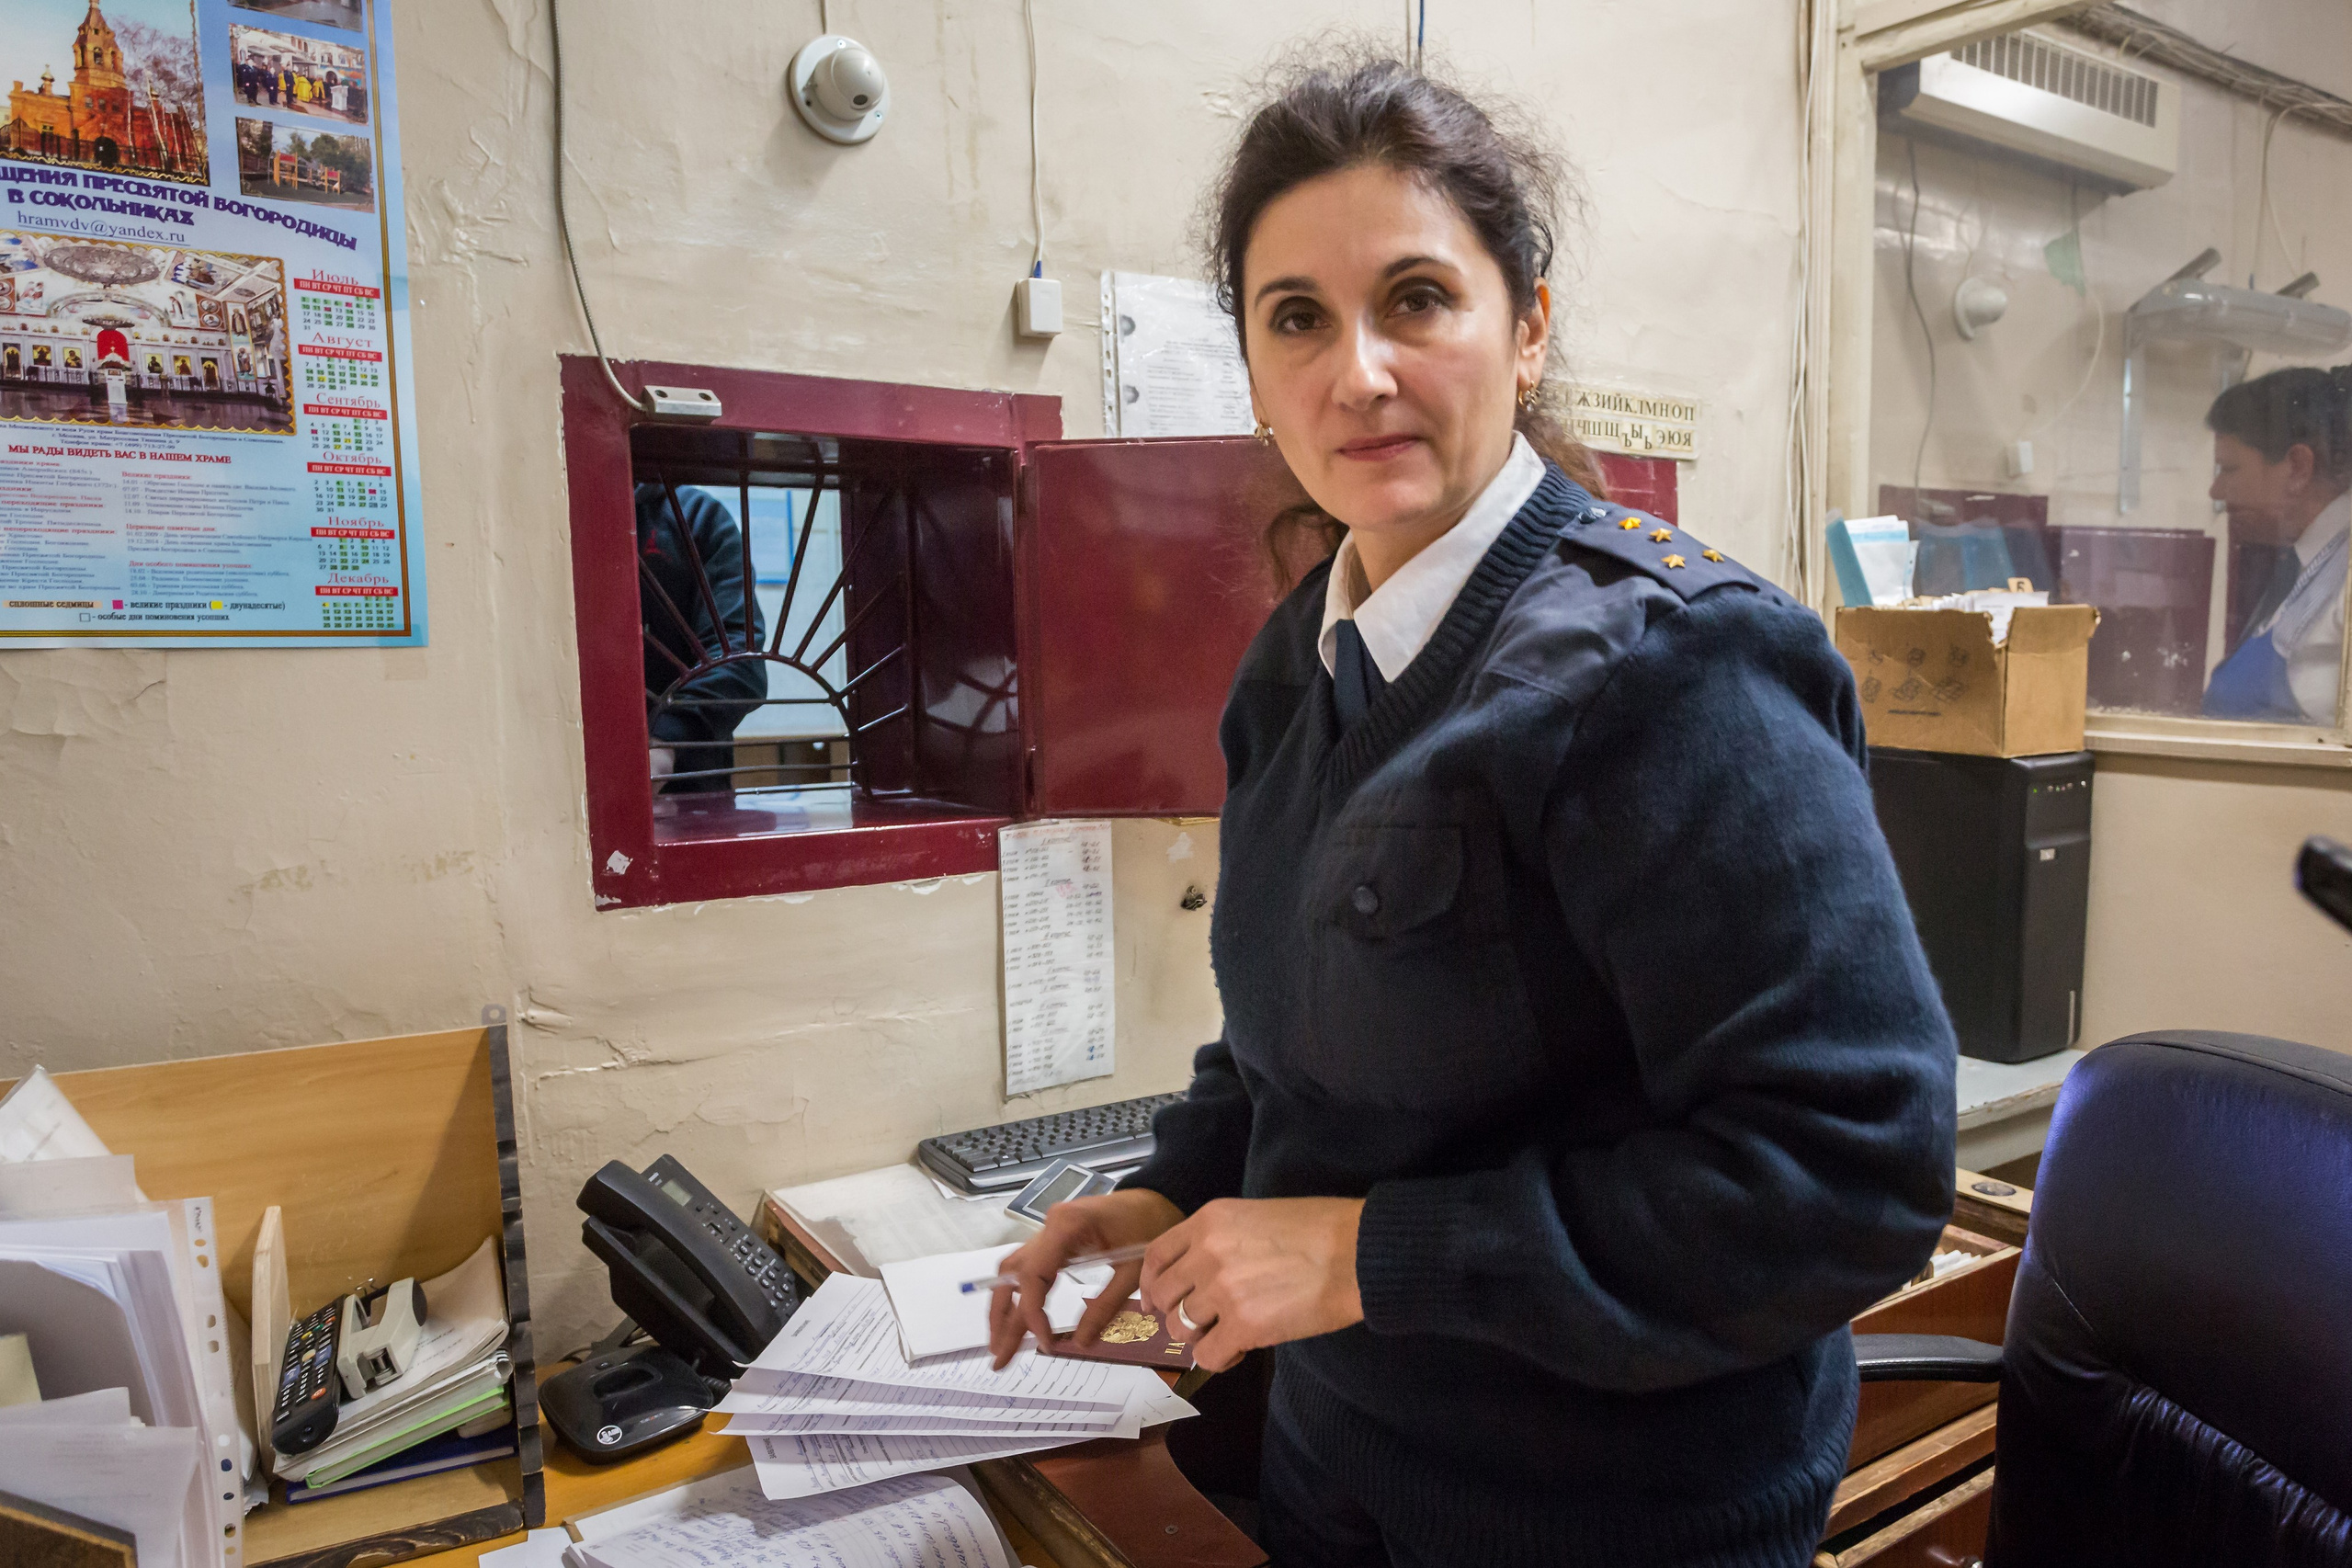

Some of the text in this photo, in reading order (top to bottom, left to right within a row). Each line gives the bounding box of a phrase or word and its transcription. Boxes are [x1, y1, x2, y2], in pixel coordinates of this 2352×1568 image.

[7, 188, 194, 226] В СОКОЛЬНИКАХ
[83, 175, 210, 208] ПРЕСВЯТОЙ
[213, 196, 358, 251] БОГОРОДИЦЫ
[17, 210, 186, 243] hramvdv@yandex.ru
[312, 269, 358, 285] Июль
[312, 333, 372, 348] Август
[316, 392, 381, 408] Сентябрь
[8, 445, 29, 453] МЫ
[32, 446, 64, 456] РАДЫ
[67, 448, 111, 458] ВИДЕТЬ
[114, 450, 137, 460] ВАС
[150, 452, 192, 461] НАШЕМ
[195, 455, 232, 464] ХРАМЕ
[324, 451, 381, 465] Октябрь
[329, 517, 384, 528] Ноябрь
[328, 573, 389, 585] Декабрь
[9, 600, 94, 609] сплошные седмицы
[165, 602, 207, 610] праздники
[197, 614, 230, 622] усопших
